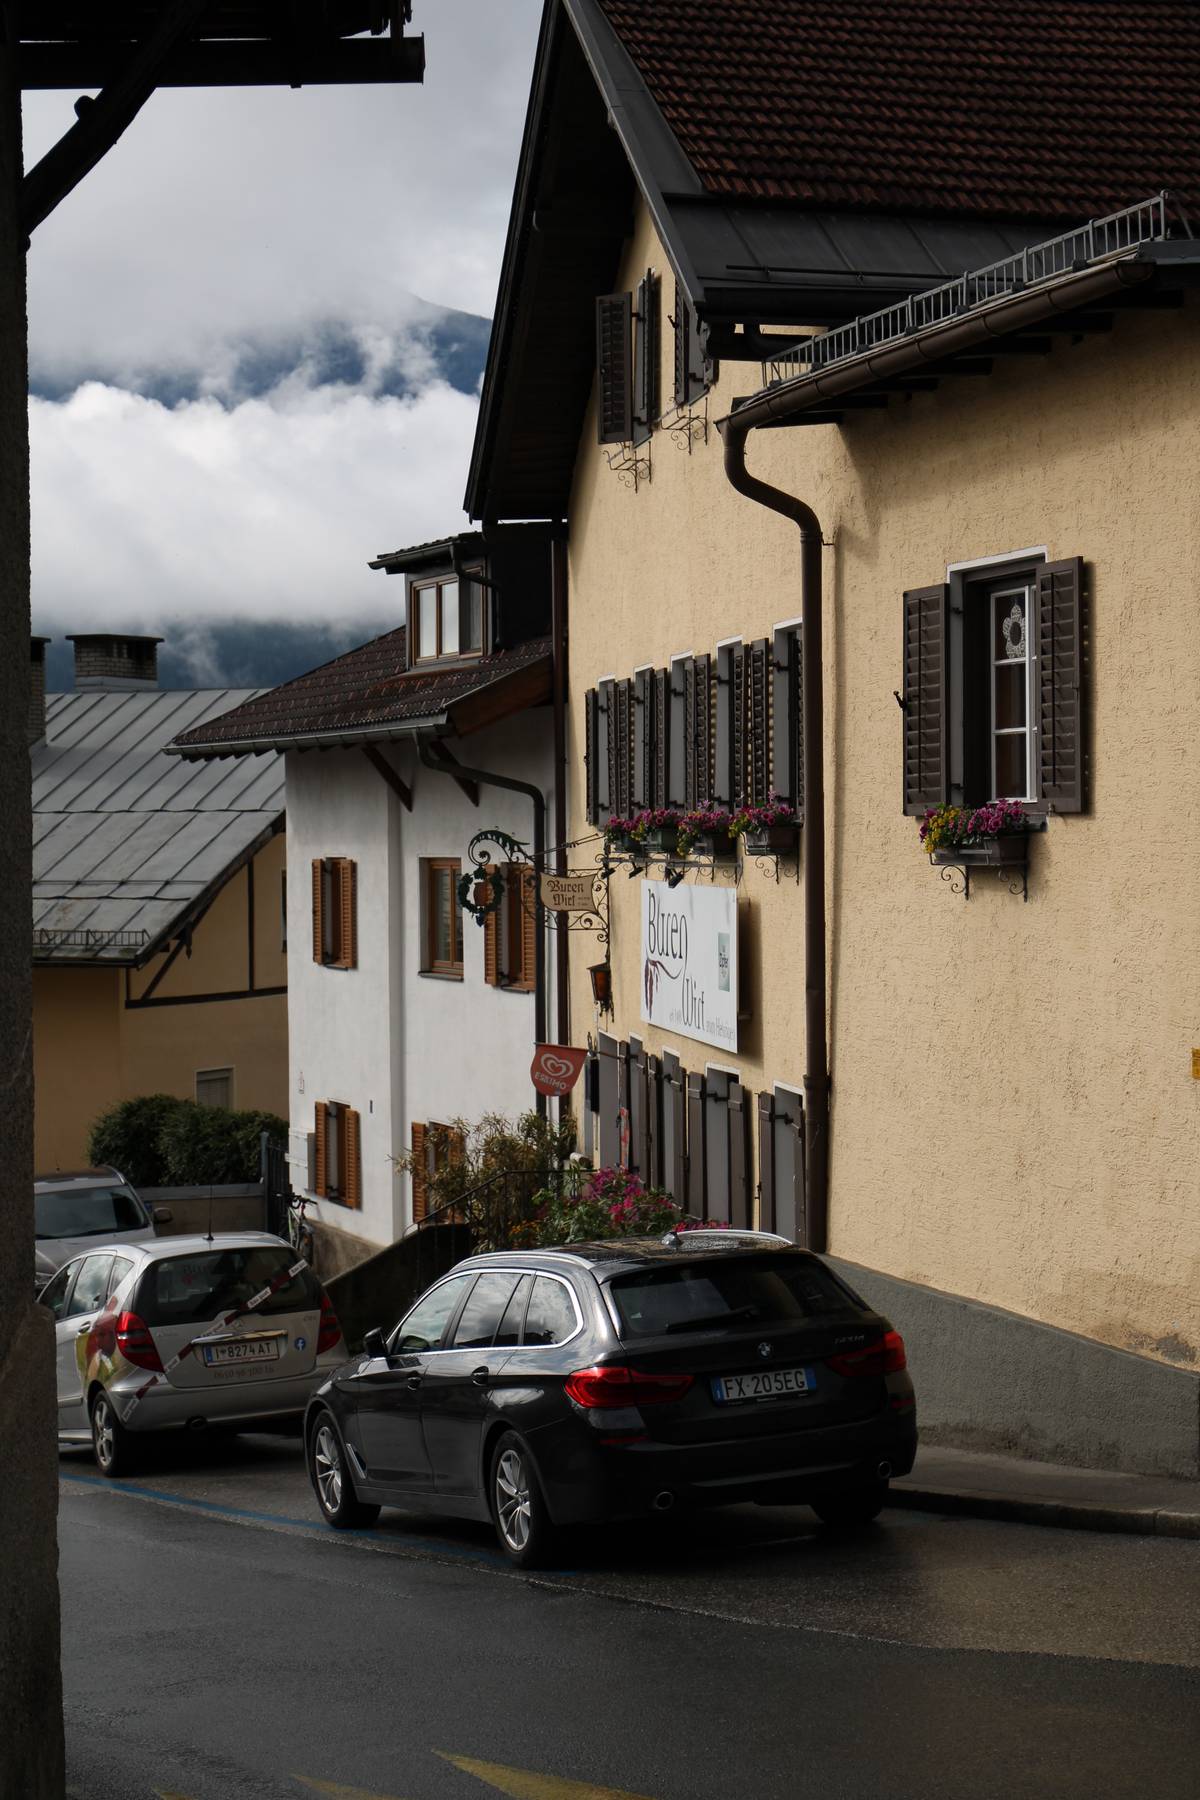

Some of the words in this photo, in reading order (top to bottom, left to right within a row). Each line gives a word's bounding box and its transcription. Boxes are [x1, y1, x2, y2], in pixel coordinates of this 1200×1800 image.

[547, 879, 584, 893] Buren
[553, 893, 575, 906] Wirt
[647, 889, 688, 960] Buren
[535, 1071, 567, 1089] ESKIMO
